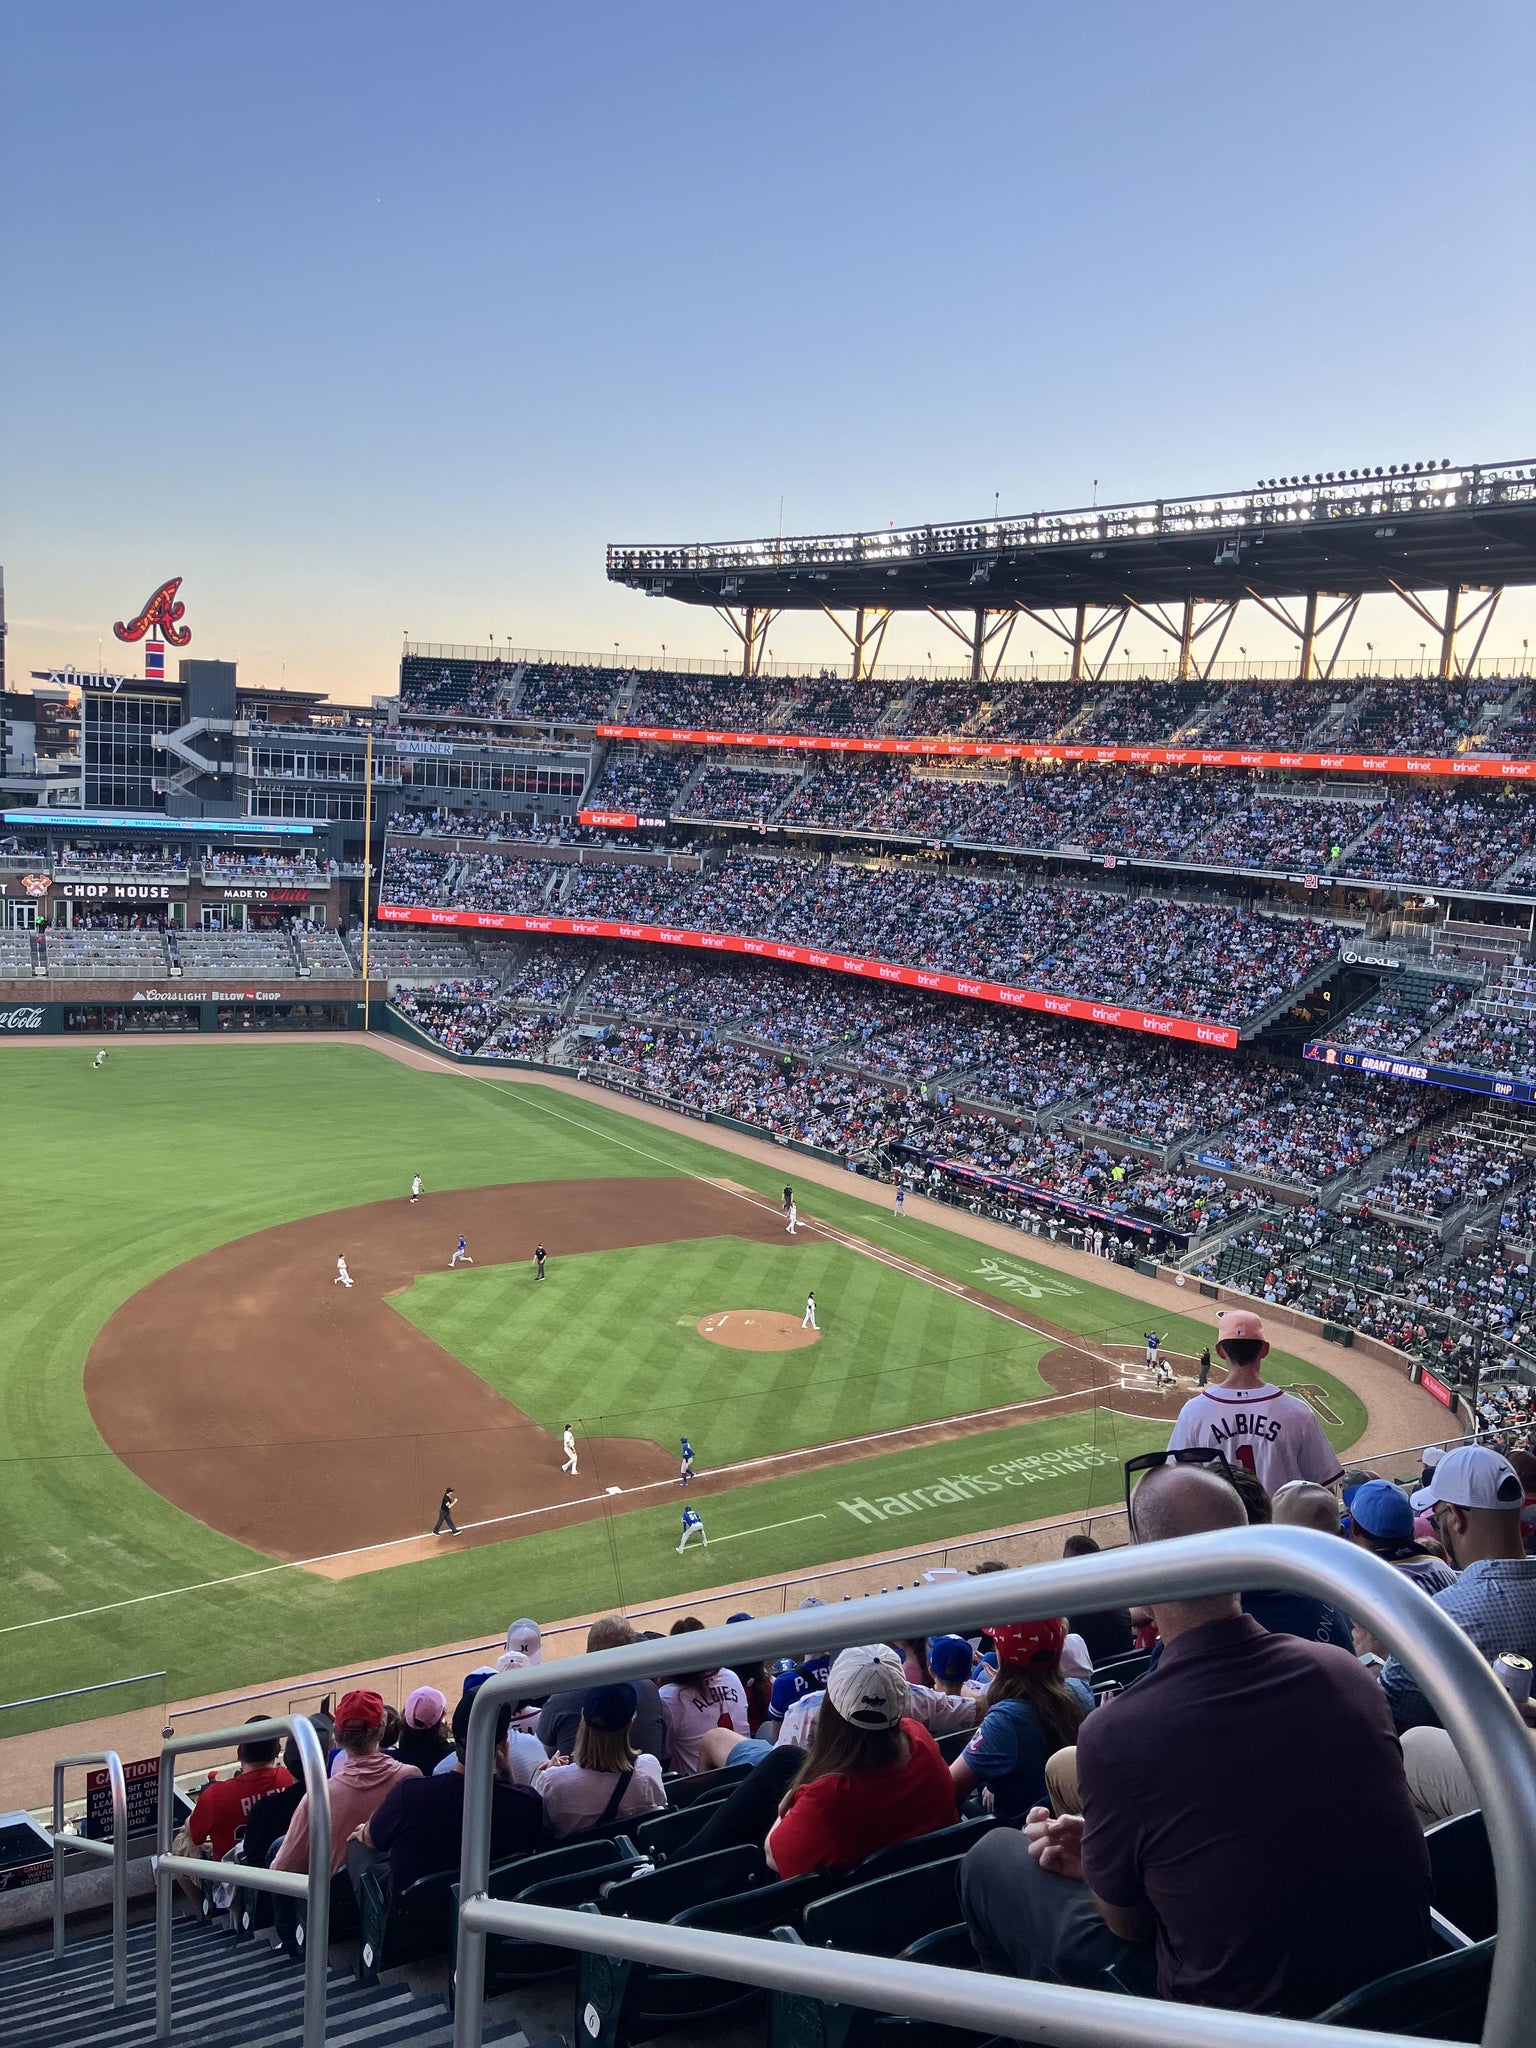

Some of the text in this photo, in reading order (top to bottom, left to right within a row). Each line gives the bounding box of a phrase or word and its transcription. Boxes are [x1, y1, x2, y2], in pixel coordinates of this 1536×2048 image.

[48, 664, 126, 693] xfinity
[410, 742, 450, 754] MILNER
[1202, 754, 1224, 762] trinet
[1240, 754, 1264, 764] trinet
[1280, 756, 1304, 766] trinet
[1320, 758, 1344, 766] trinet
[1362, 760, 1388, 768] trinet
[1406, 760, 1432, 770] trinet
[1454, 762, 1480, 772] trinet
[1502, 764, 1530, 774] trinet
[592, 814, 624, 824] trinet
[1104, 855, 1116, 868] 10
[1304, 874, 1318, 888] 21
[64, 885, 169, 898] CHOP HOUSE
[224, 890, 252, 898] MADE
[270, 888, 311, 901] Chill
[1358, 956, 1400, 967] LEXUS
[384, 910, 410, 918] trinet
[432, 912, 458, 922] trinet
[478, 916, 504, 926] trinet
[526, 920, 552, 930] trinet
[572, 924, 598, 932] trinet
[620, 926, 642, 936] trinet
[660, 932, 684, 942] trinet
[702, 936, 726, 946] trinet
[880, 966, 902, 980] trinet
[918, 974, 940, 986] trinet
[958, 982, 982, 994] trinet
[1000, 990, 1024, 1004] trinet
[1044, 998, 1072, 1012] trinet
[1092, 1008, 1120, 1022] trinet
[1144, 1016, 1172, 1032] trinet
[1196, 1028, 1228, 1044] trinet
[146, 989, 178, 1000] Coors
[1345, 1056, 1354, 1064] 66
[1361, 1057, 1392, 1072] GRANT
[1392, 1063, 1427, 1079] HOLMES
[1495, 1083, 1512, 1095] RHP
[1202, 1156, 1226, 1168] GEICO
[1211, 1414, 1281, 1444] ALBIES
[987, 1442, 1101, 1476] CHEROKEE
[1236, 1445, 1256, 1475] 1
[1004, 1452, 1120, 1486] CASINOS
[692, 1686, 738, 1712] ALBIES
[96, 1761, 156, 1784] CATION
[128, 1784, 141, 1792] SIT
[93, 1792, 105, 1800] DO
[92, 1797, 158, 1818] PLAC BJECTS
[128, 1807, 150, 1818] ILING
[130, 1817, 147, 1826] DGE
[28, 1870, 52, 1878] WATCH
[20, 1878, 40, 1886] YOUR
